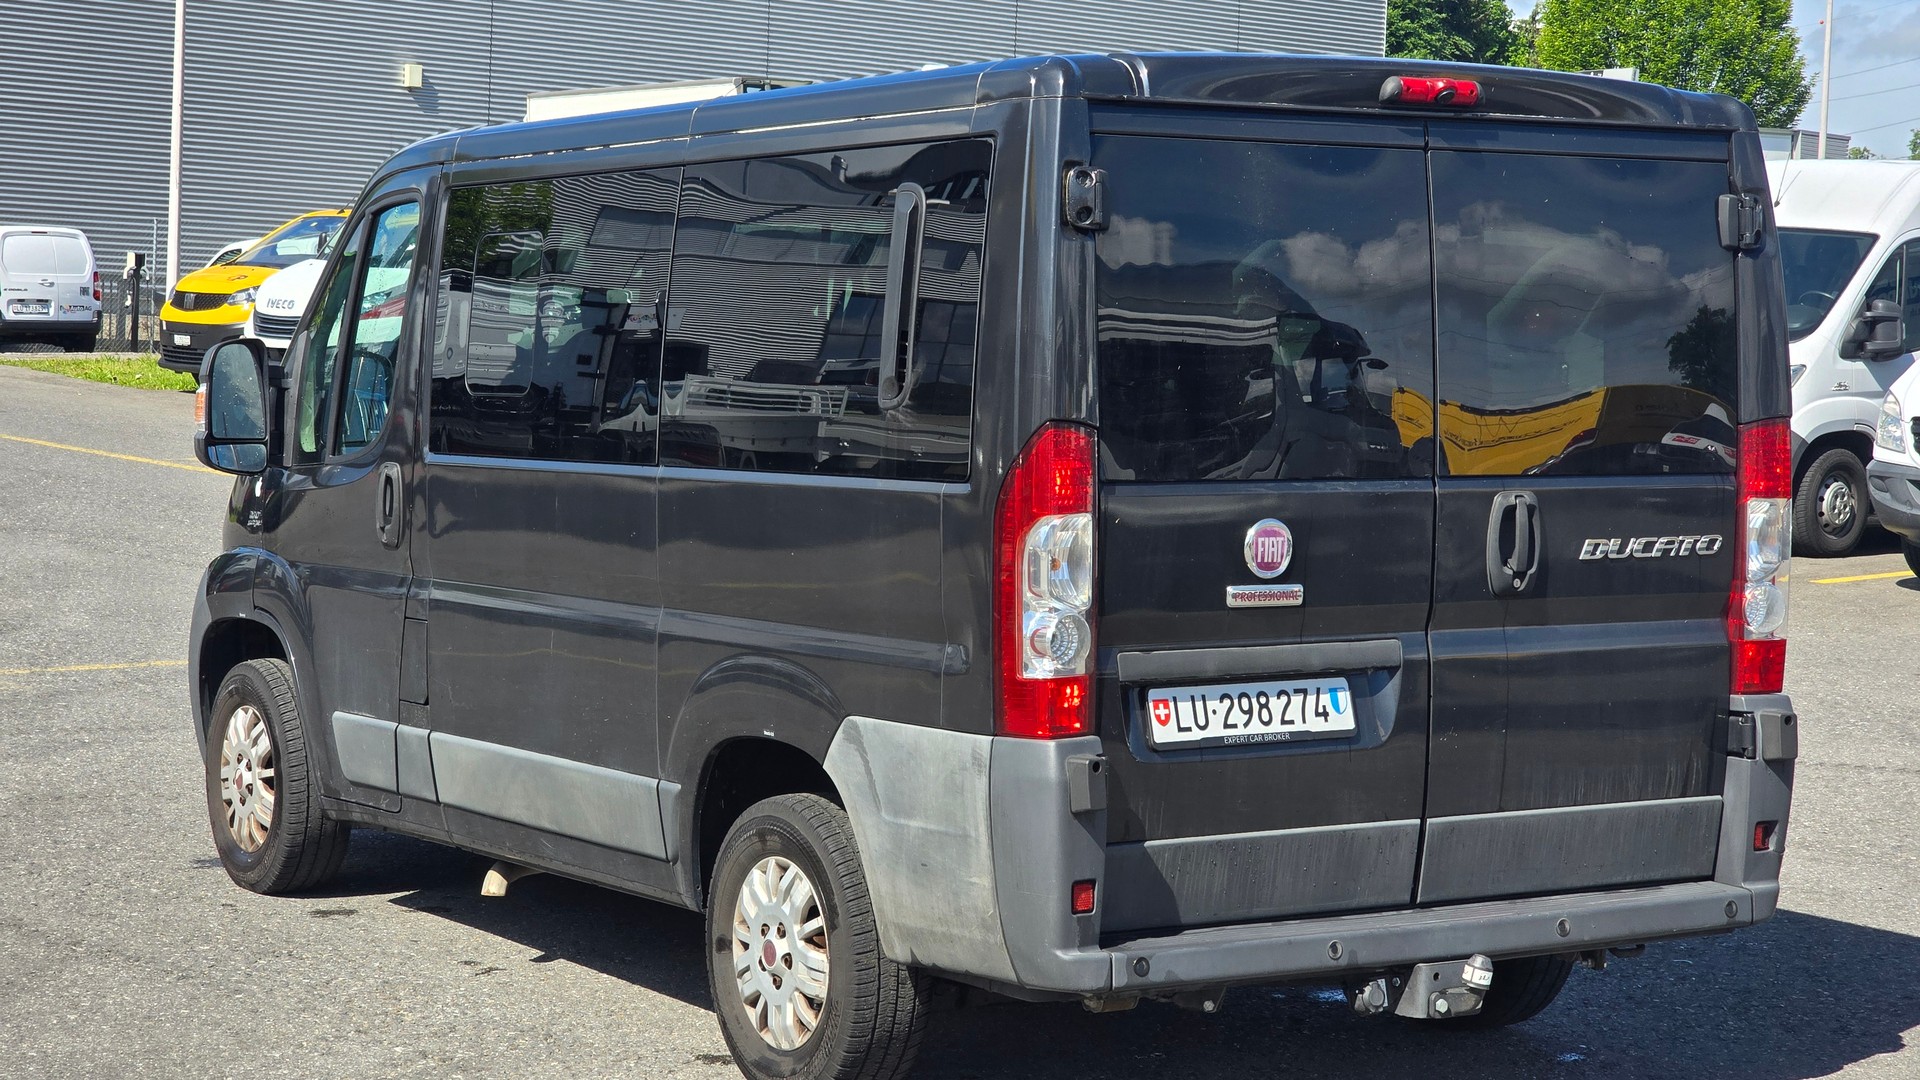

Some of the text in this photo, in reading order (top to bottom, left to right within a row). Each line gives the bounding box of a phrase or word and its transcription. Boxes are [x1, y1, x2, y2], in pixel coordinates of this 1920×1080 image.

[266, 298, 295, 310] IVECO
[1257, 536, 1285, 563] FIAT
[1578, 534, 1723, 560] DUCATO
[1233, 589, 1299, 603] PROFESSIONAL
[1223, 732, 1291, 744] EXPERT CAR BROKER
